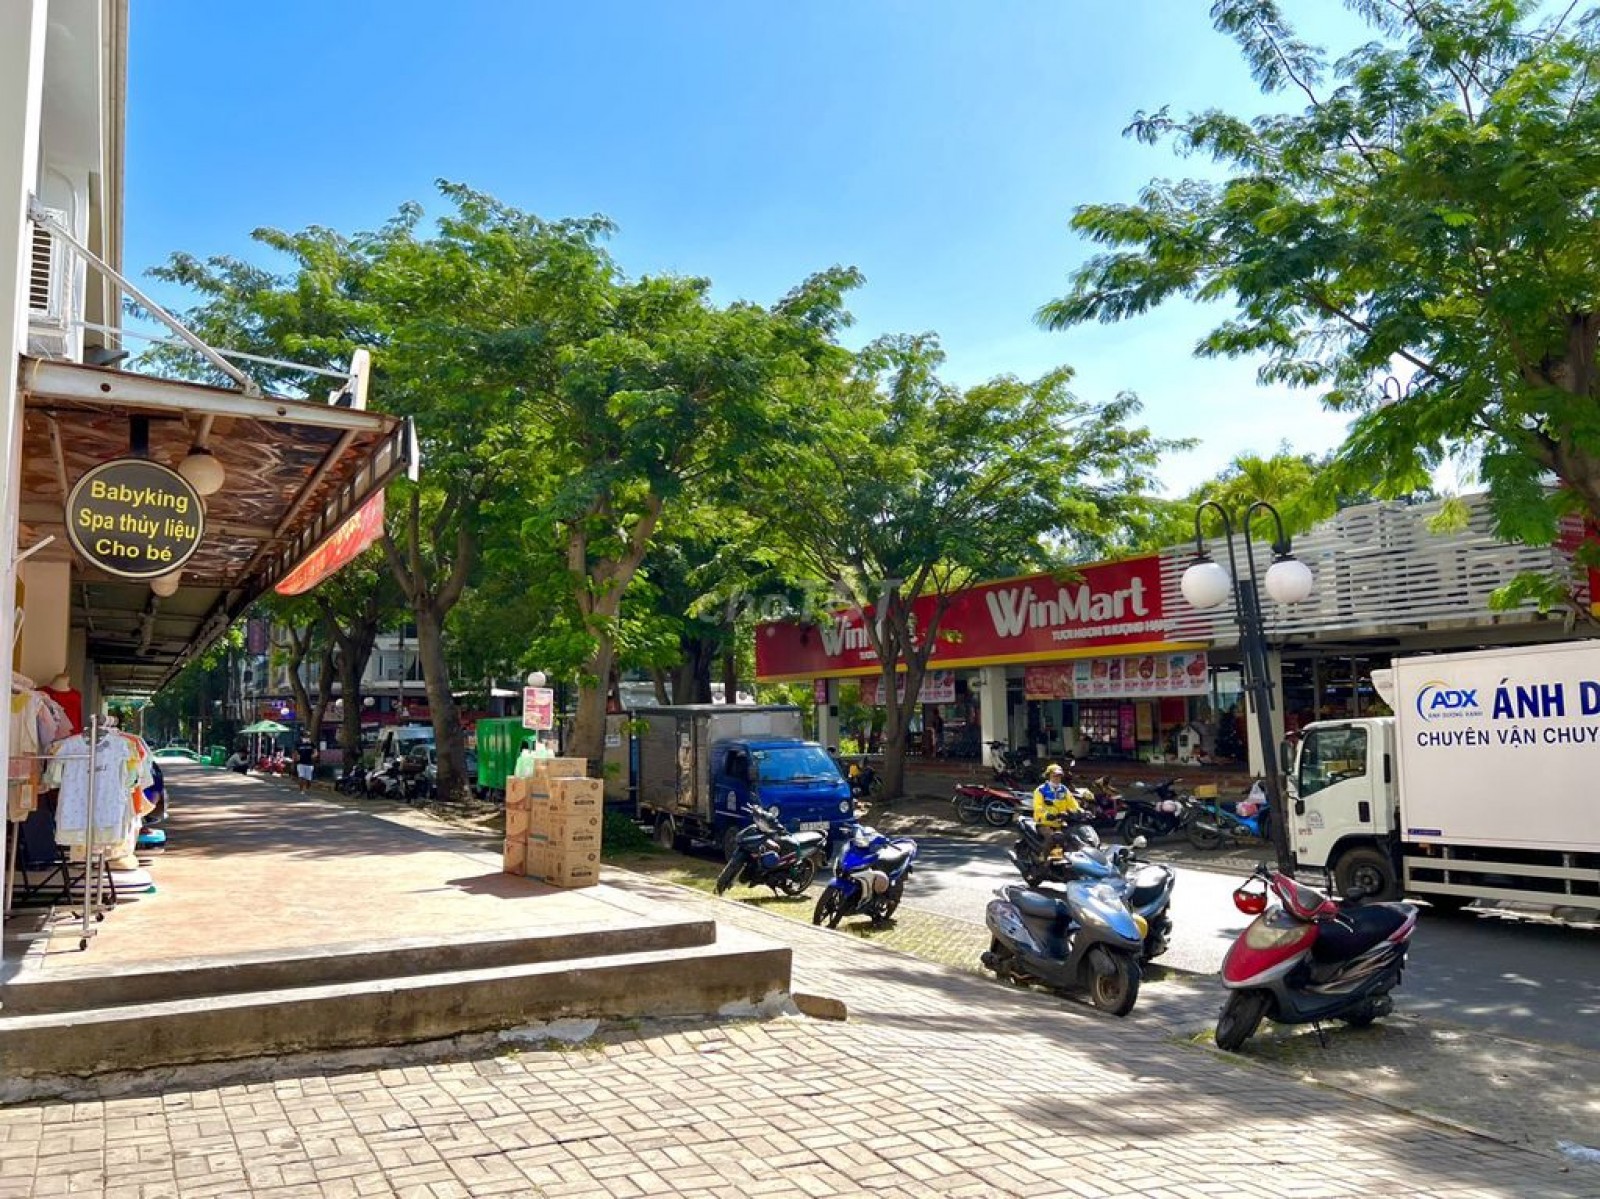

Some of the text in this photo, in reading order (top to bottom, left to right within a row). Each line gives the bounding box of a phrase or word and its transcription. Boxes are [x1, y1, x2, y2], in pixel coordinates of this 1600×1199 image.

[90, 480, 189, 513] Babyking
[79, 507, 196, 542] Spa thủy liệu
[96, 538, 172, 561] Cho bé
[985, 576, 1149, 637] WinMart
[1430, 689, 1479, 709] ADX
[1492, 677, 1565, 720] ÁNH
[1416, 725, 1600, 748] CHUYÊN VẬN CHUY
